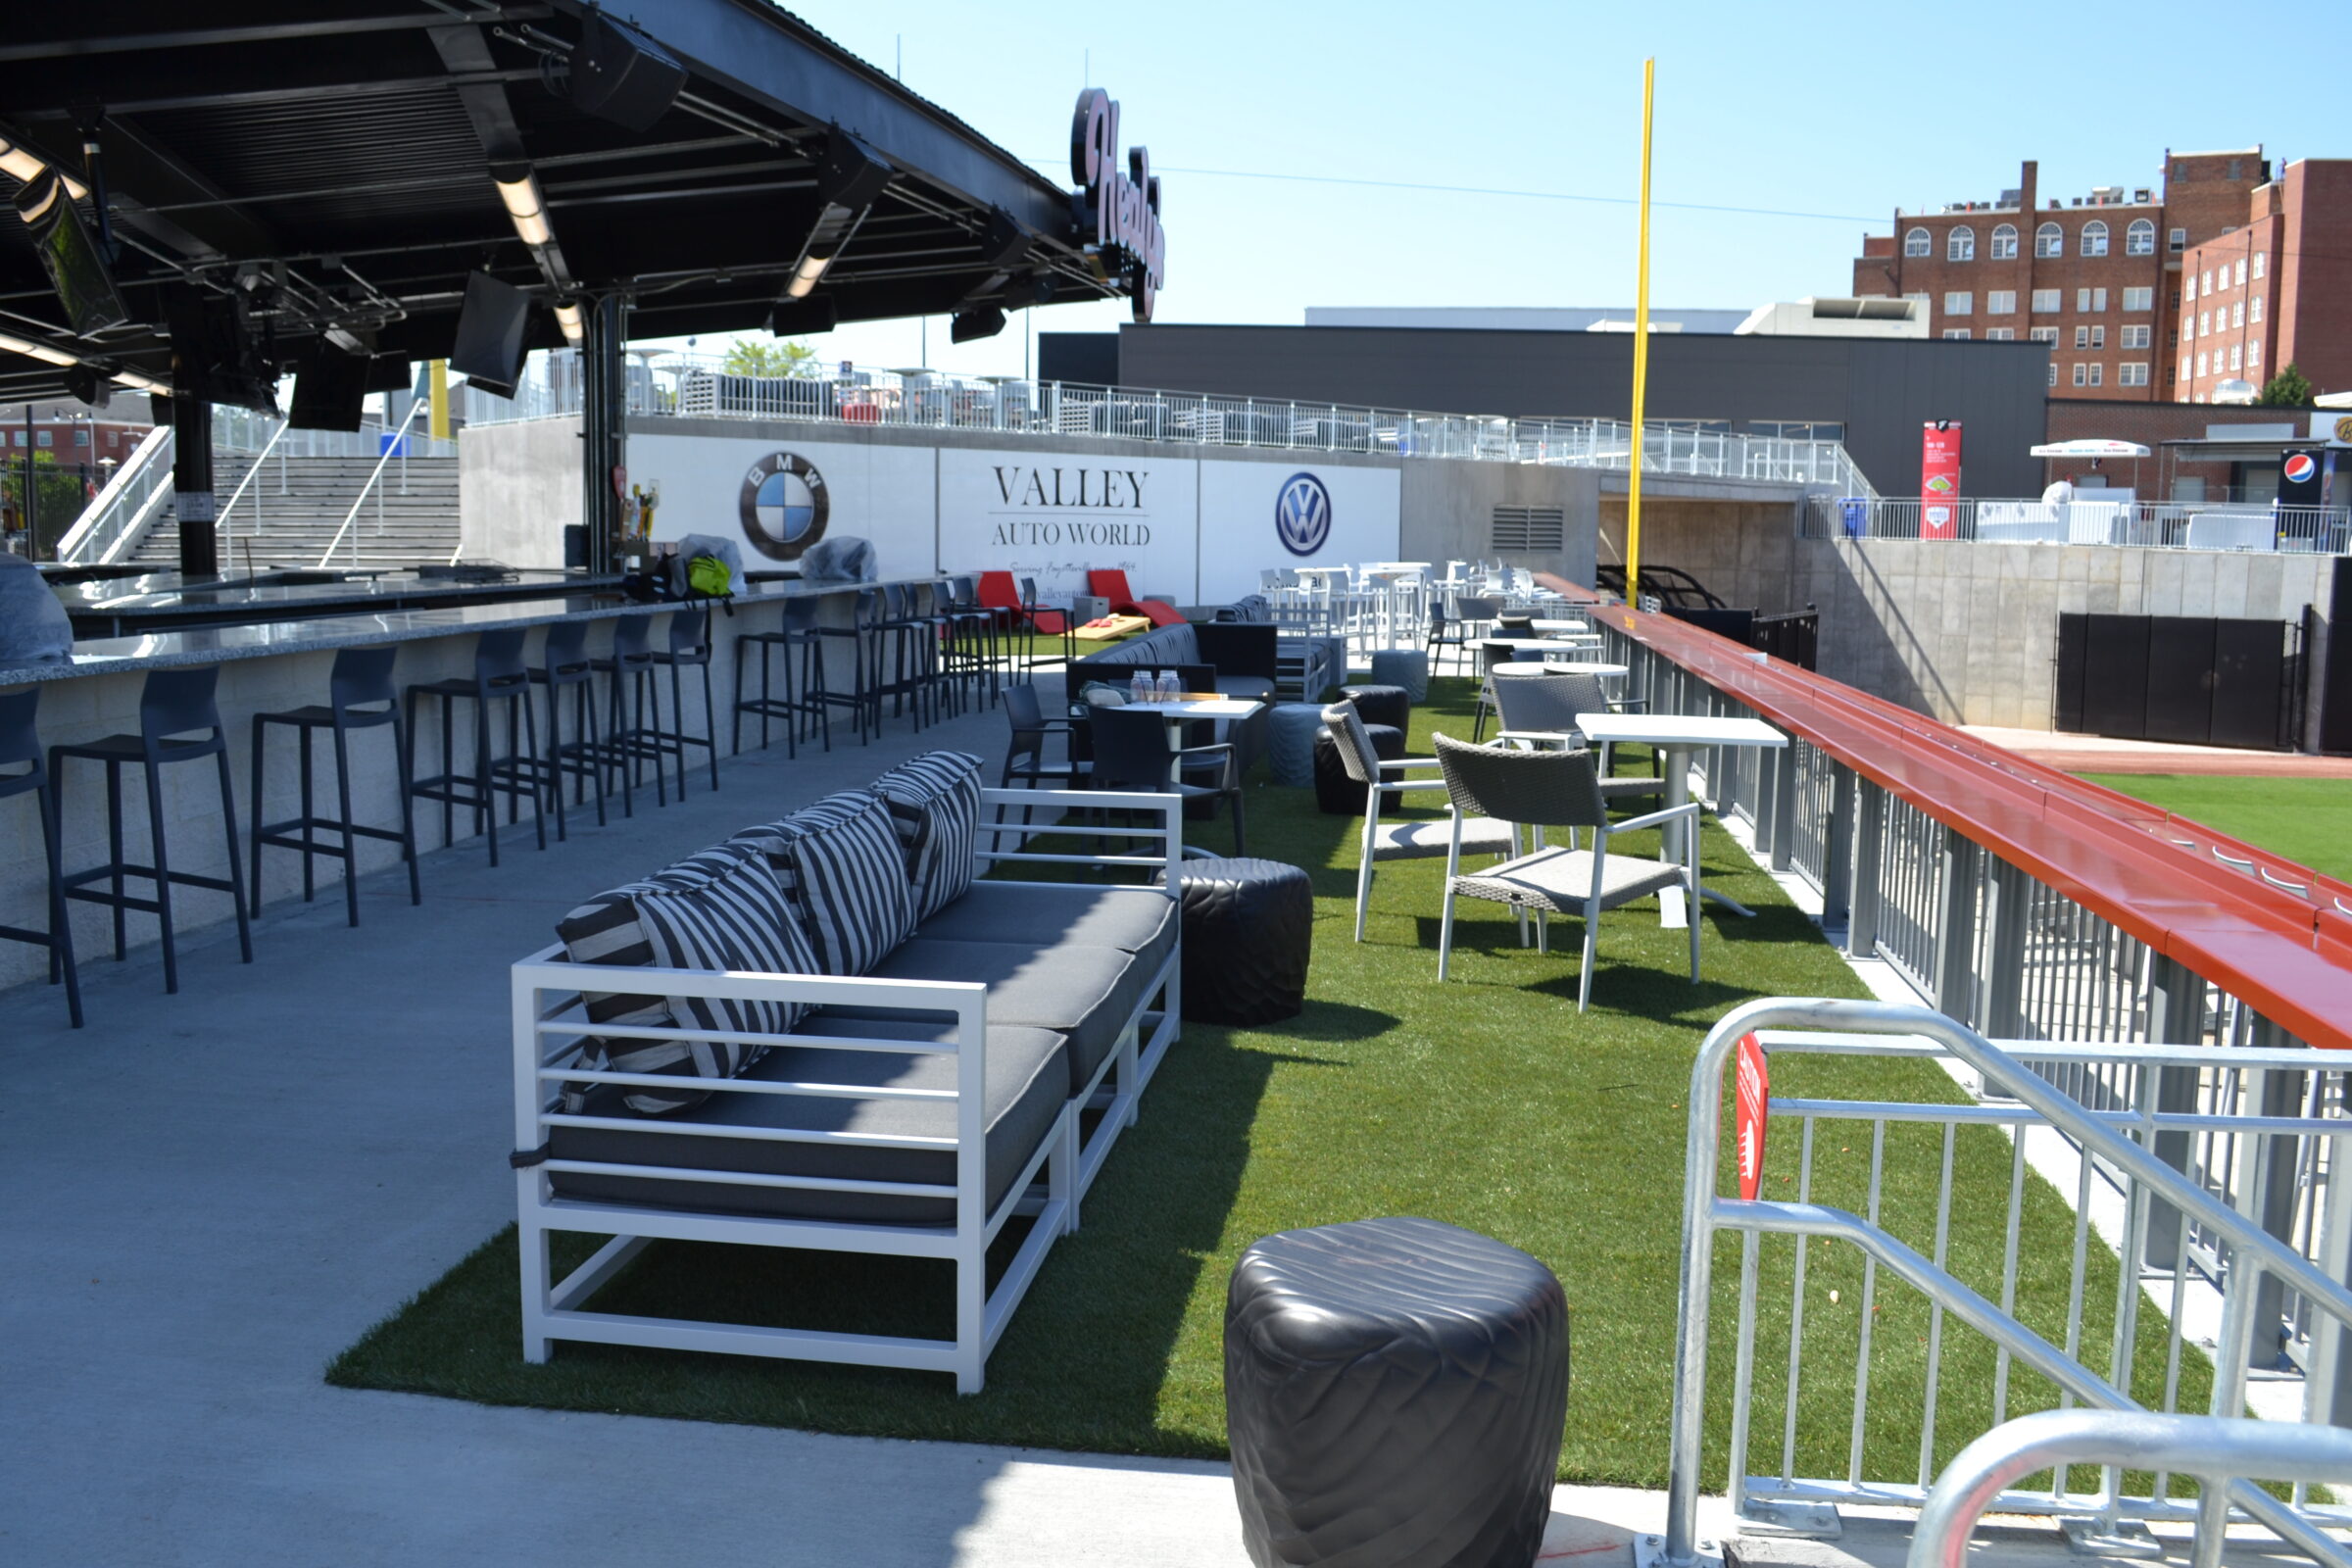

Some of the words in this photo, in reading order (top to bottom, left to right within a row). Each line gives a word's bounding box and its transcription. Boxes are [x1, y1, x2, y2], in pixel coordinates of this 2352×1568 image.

[748, 454, 822, 489] BMW
[992, 466, 1151, 509] VALLEY
[992, 521, 1060, 546] AUTO
[1067, 522, 1151, 547] WORLD
[1279, 477, 1328, 552] VW
